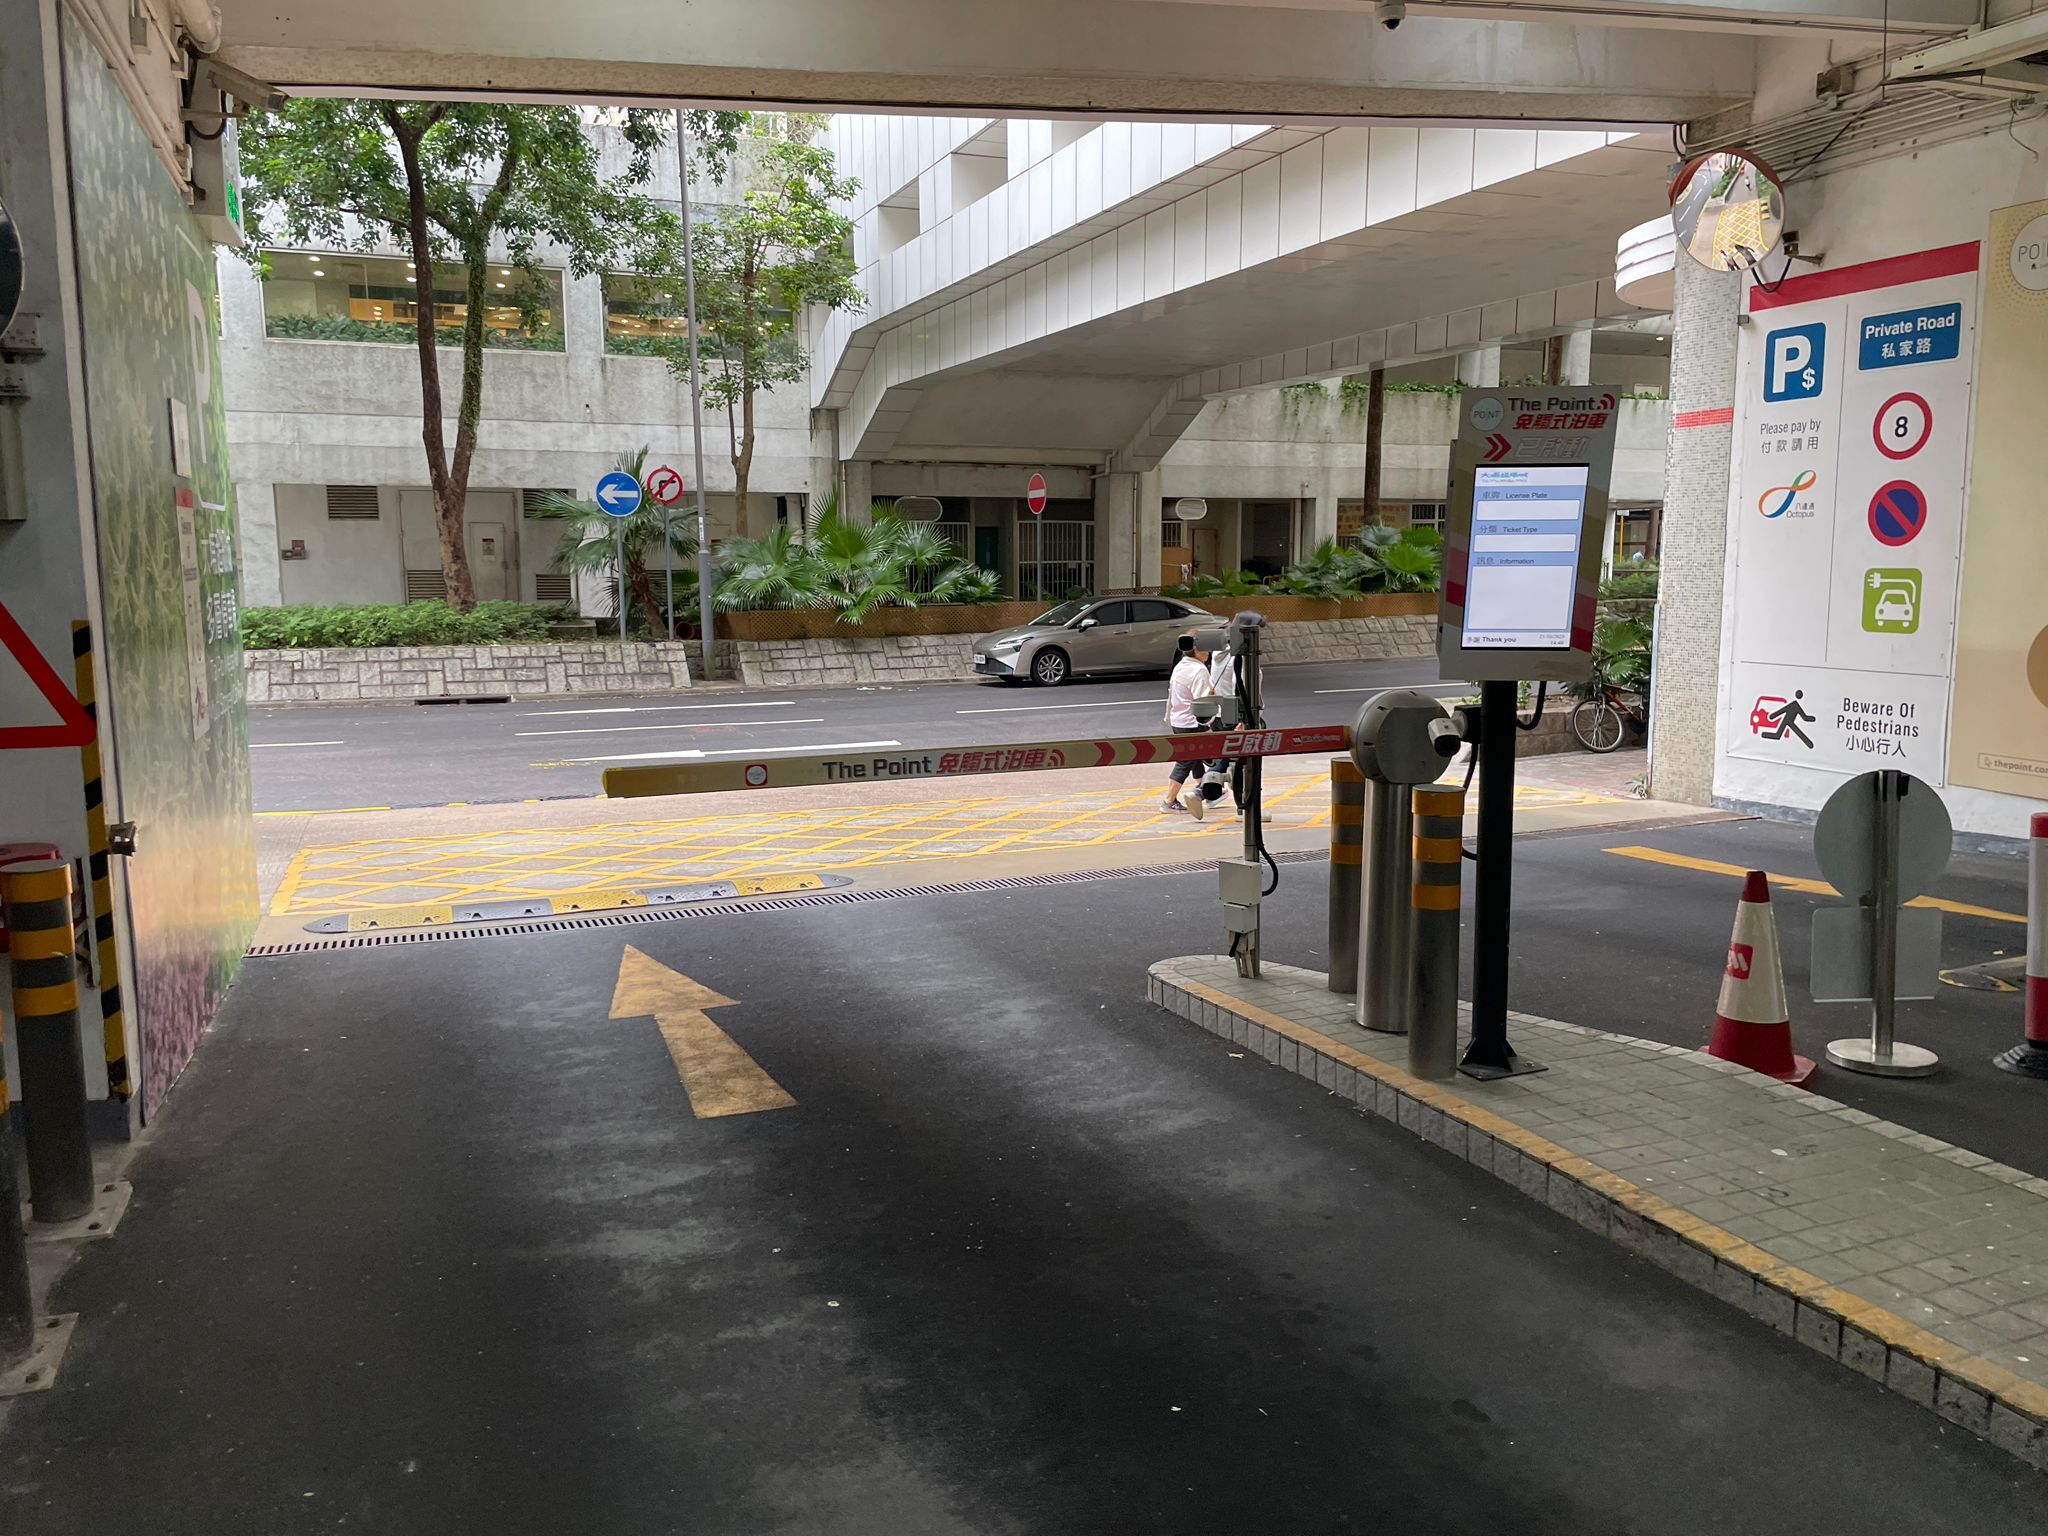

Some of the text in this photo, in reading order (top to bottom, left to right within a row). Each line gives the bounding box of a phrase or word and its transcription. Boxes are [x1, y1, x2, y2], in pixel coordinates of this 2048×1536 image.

[2018, 243, 2048, 263] POI
[1865, 312, 1956, 339] Private Road
[1881, 337, 1932, 359] 私家路
[1772, 334, 1812, 394] P
[1473, 410, 1500, 419] POINT
[1508, 397, 1596, 411] The Point
[1513, 413, 1609, 430] 免觸式泊車
[1760, 418, 1822, 435] Please pay by
[1894, 415, 1908, 437] 8
[1786, 510, 1815, 519] Octopus
[1523, 526, 1538, 534] Type
[1843, 697, 1915, 718] Beware Of
[1837, 714, 1919, 738] Pedestrians
[1221, 731, 1283, 755] 已啟動
[1845, 734, 1906, 758] 小心行人
[822, 748, 1046, 780] The Point 免觸式泊車
